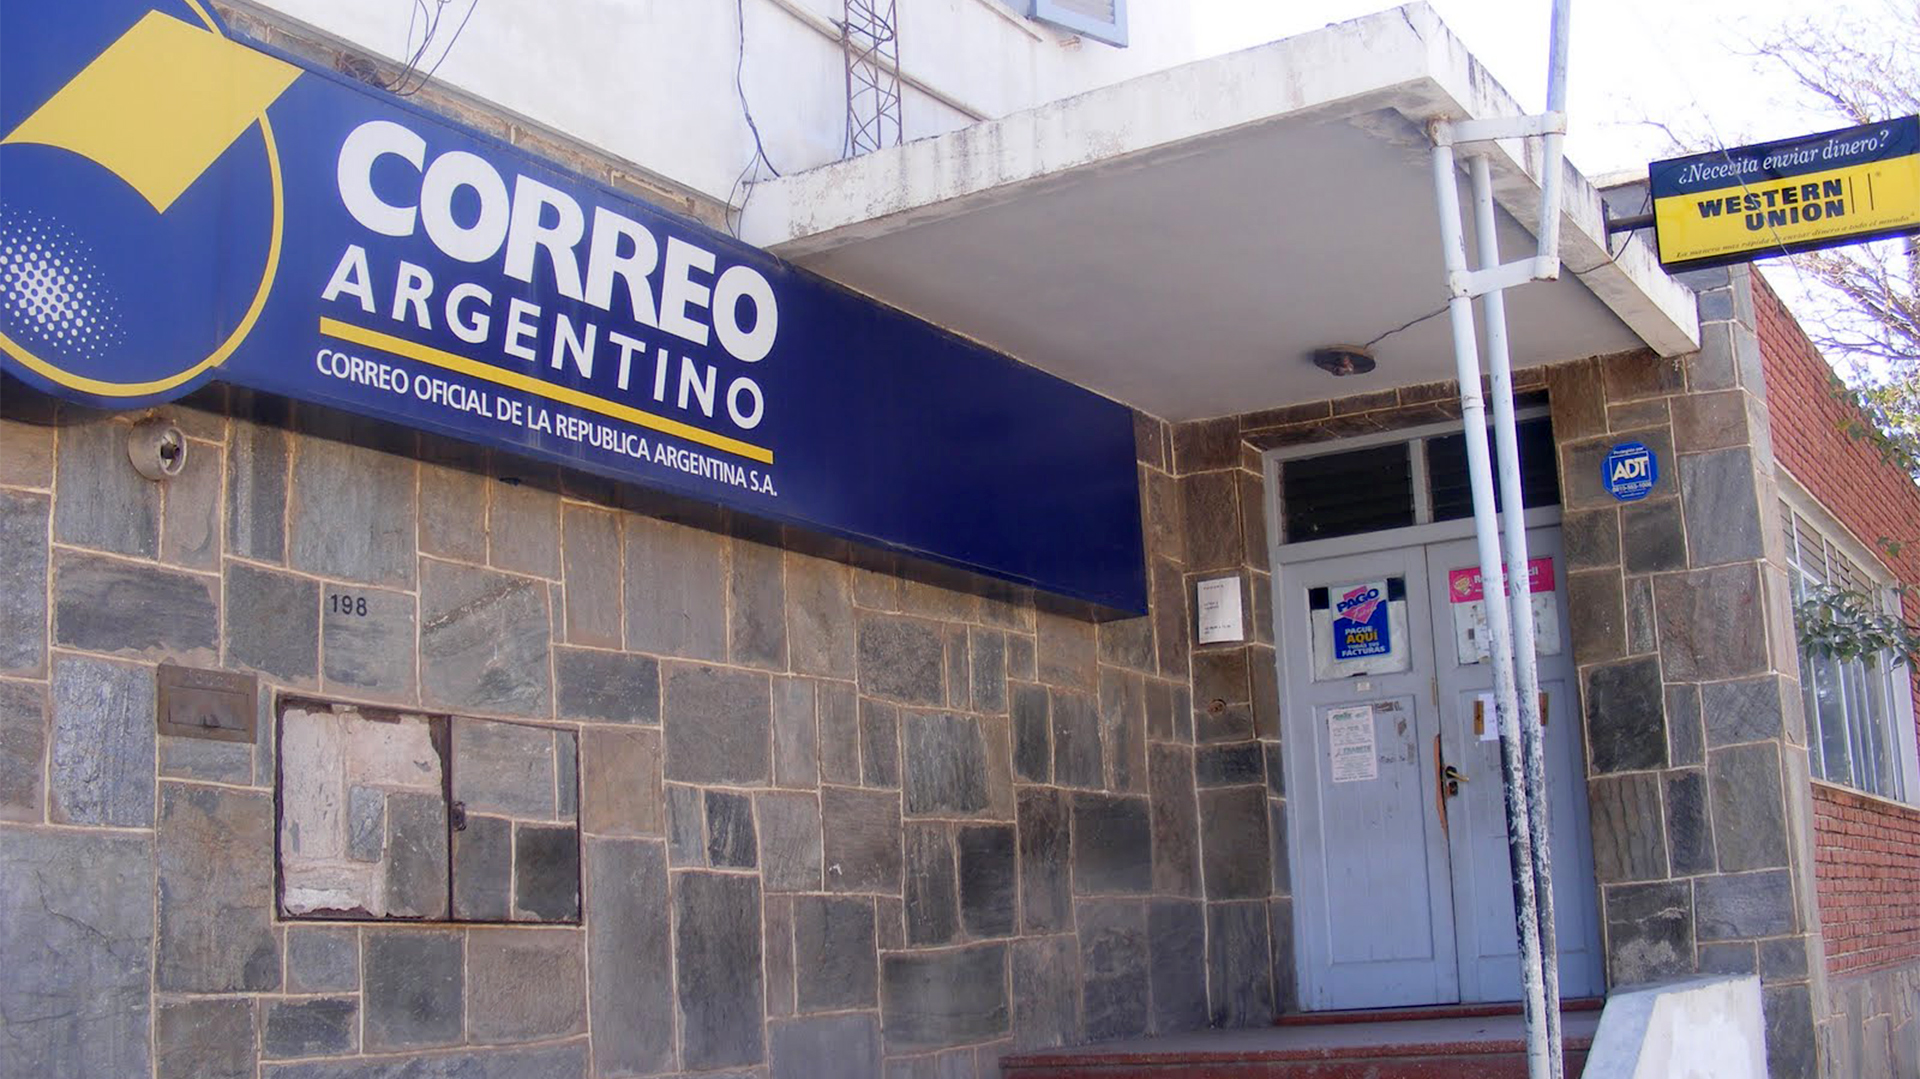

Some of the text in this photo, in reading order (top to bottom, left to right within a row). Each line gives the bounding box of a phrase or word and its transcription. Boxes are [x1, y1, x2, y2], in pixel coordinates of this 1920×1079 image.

[1678, 130, 1890, 184] ¿Necesita enviar dinero?
[1698, 178, 1843, 219] WESTERN
[1745, 199, 1845, 231] UNION
[337, 120, 778, 362] CORREO
[321, 244, 765, 430] ARGENTINO
[316, 349, 778, 497] CORREO OFICIAL DE LA REPUBLICA ARGENTINA S.A.
[1612, 456, 1649, 481] ADT
[330, 594, 367, 617] 198
[1336, 588, 1379, 613] PAGO
[1345, 626, 1373, 635] PAGUE
[1341, 645, 1386, 657] FACTURAS
